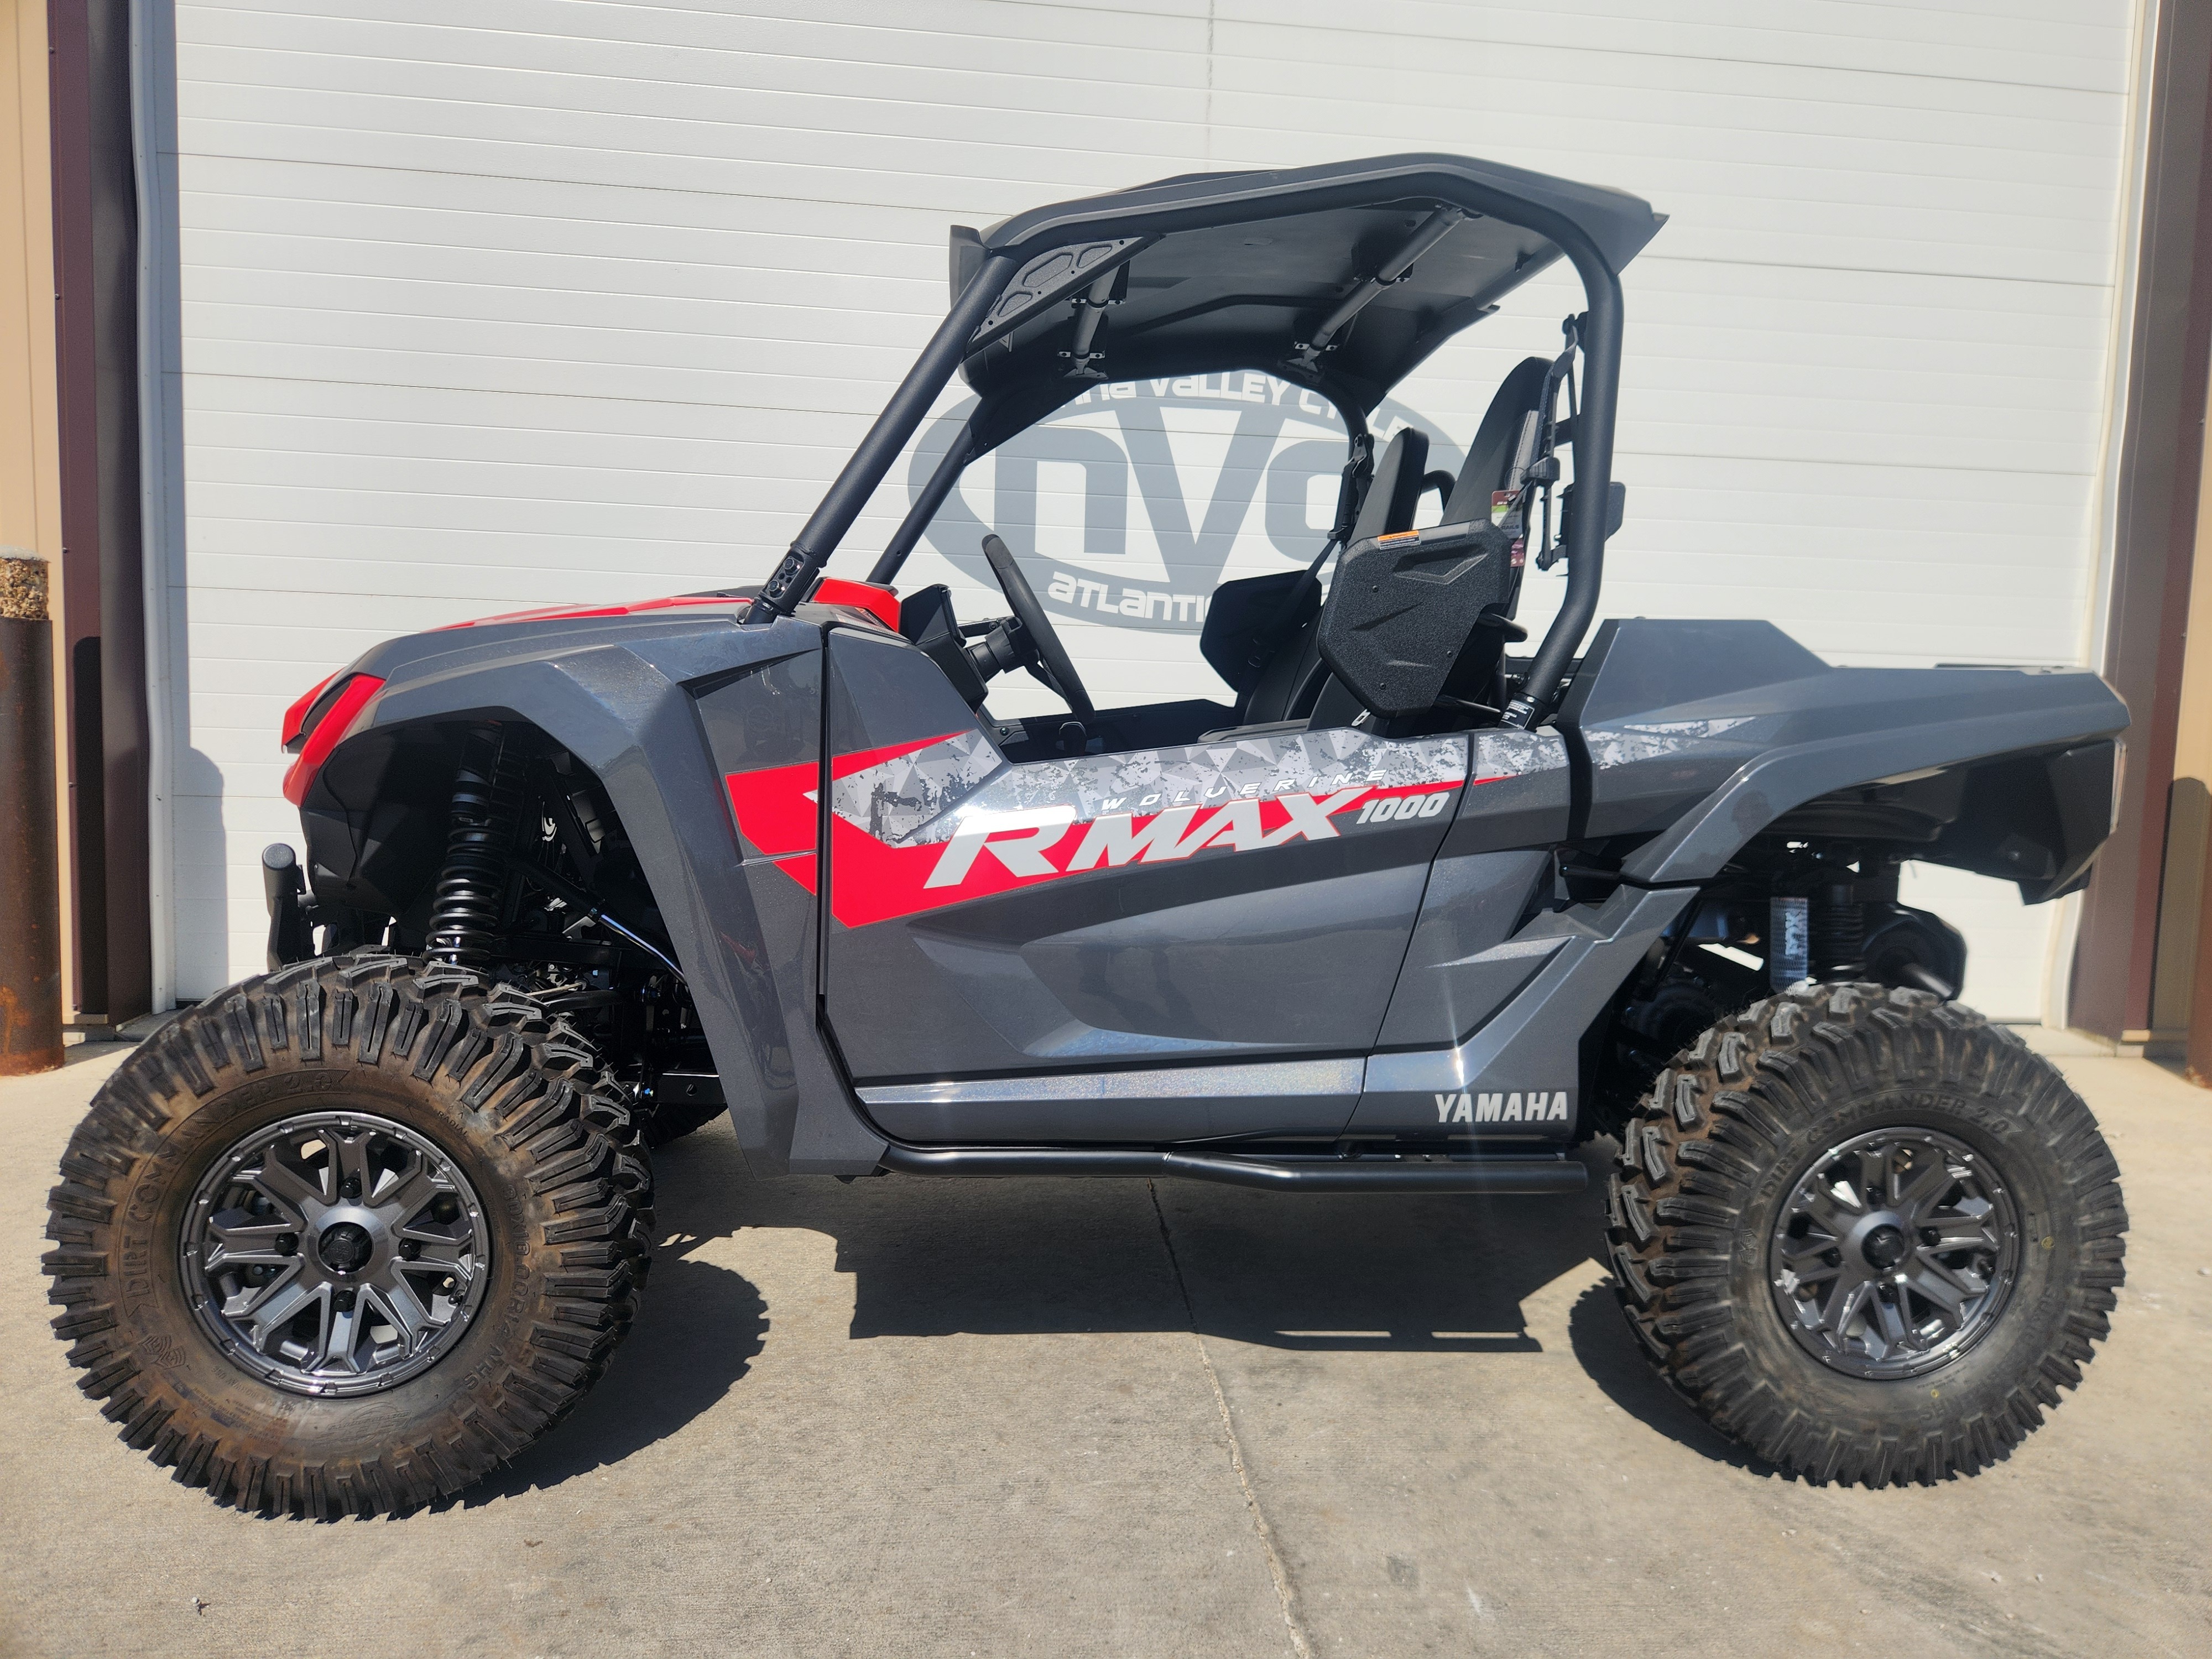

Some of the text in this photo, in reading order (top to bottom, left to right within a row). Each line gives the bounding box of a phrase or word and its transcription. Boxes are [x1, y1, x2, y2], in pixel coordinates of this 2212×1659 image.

[1102, 769, 1387, 811] WOLVERINE
[923, 785, 1450, 889] RMAX 1000
[437, 1110, 468, 1138] RADIAL
[1434, 1092, 1567, 1123] YAMAHA
[123, 1235, 150, 1298] DIRT
[463, 1343, 505, 1390] NHS
